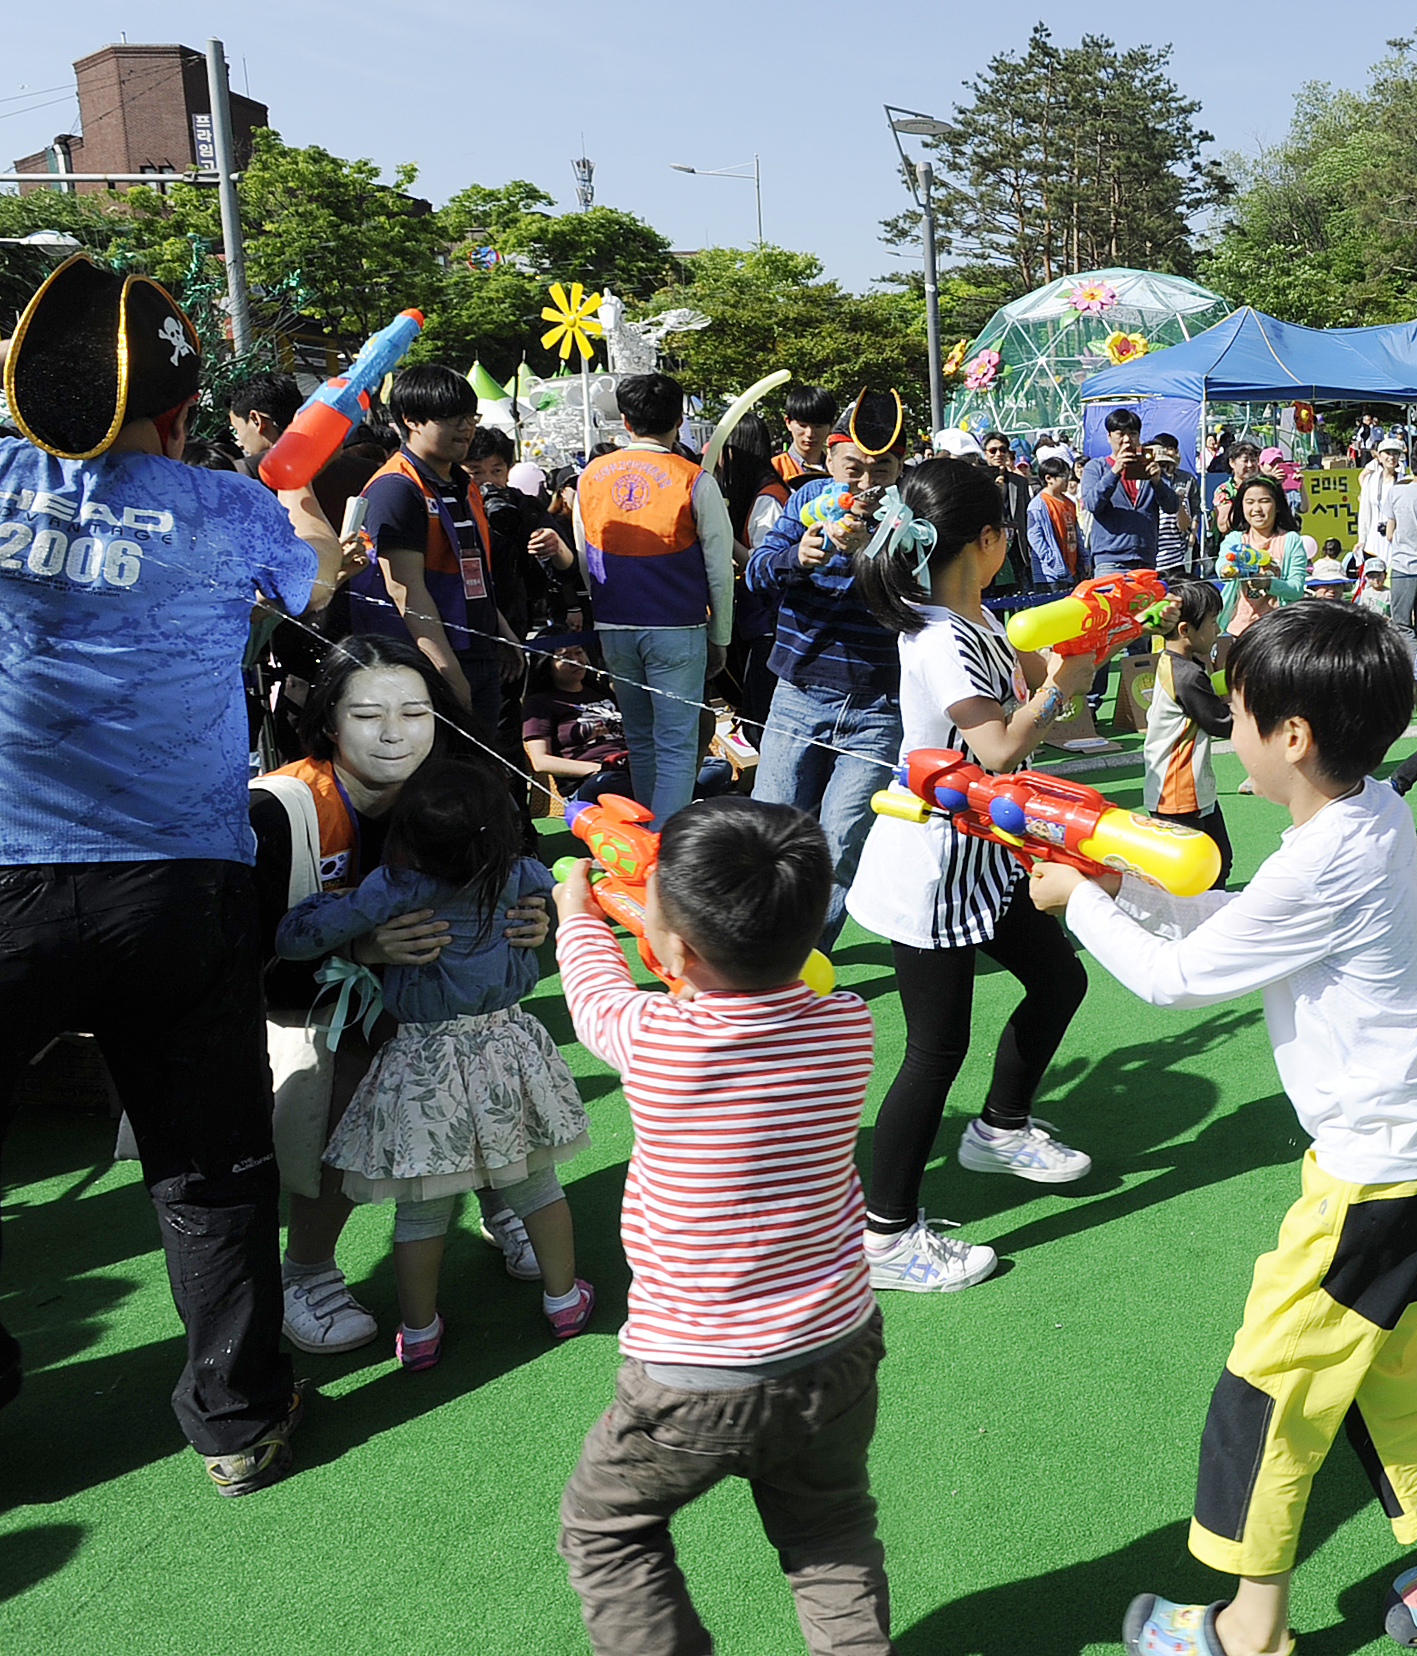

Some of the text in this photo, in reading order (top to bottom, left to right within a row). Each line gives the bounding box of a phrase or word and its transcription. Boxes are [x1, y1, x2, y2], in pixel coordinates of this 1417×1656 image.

[1311, 476, 1348, 494] 2015
[0, 507, 173, 544] DVANTAGE
[0, 521, 143, 587] 2006
